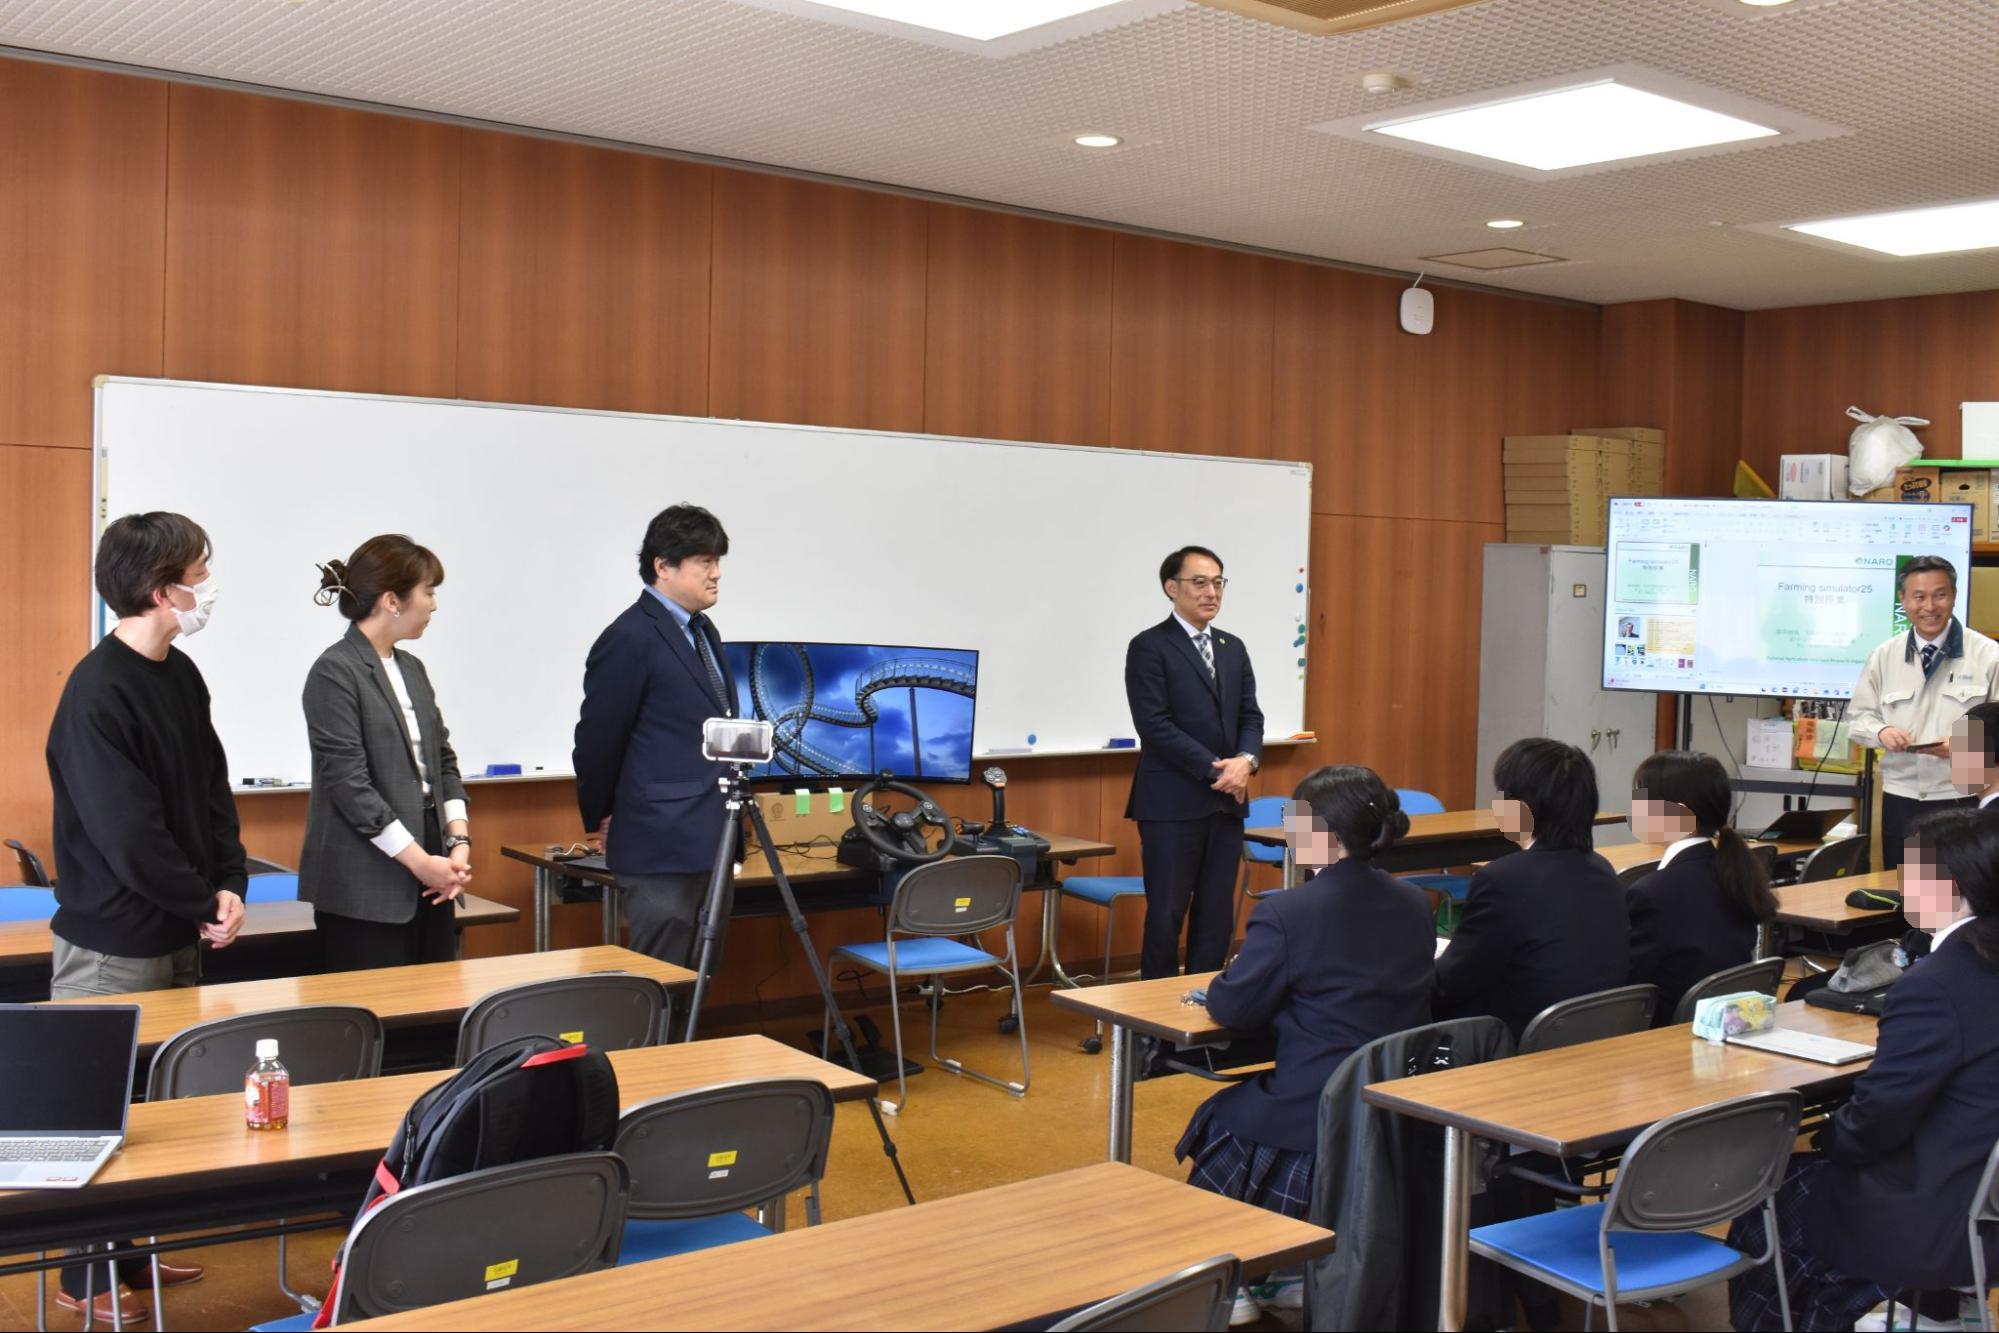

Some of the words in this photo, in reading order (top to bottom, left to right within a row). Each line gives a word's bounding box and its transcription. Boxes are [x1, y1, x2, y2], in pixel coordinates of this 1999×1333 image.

[1863, 557, 1894, 566] NARO
[1777, 582, 1816, 594] Farming
[1818, 583, 1873, 594] simulator25
[1894, 602, 1907, 635] NAR
